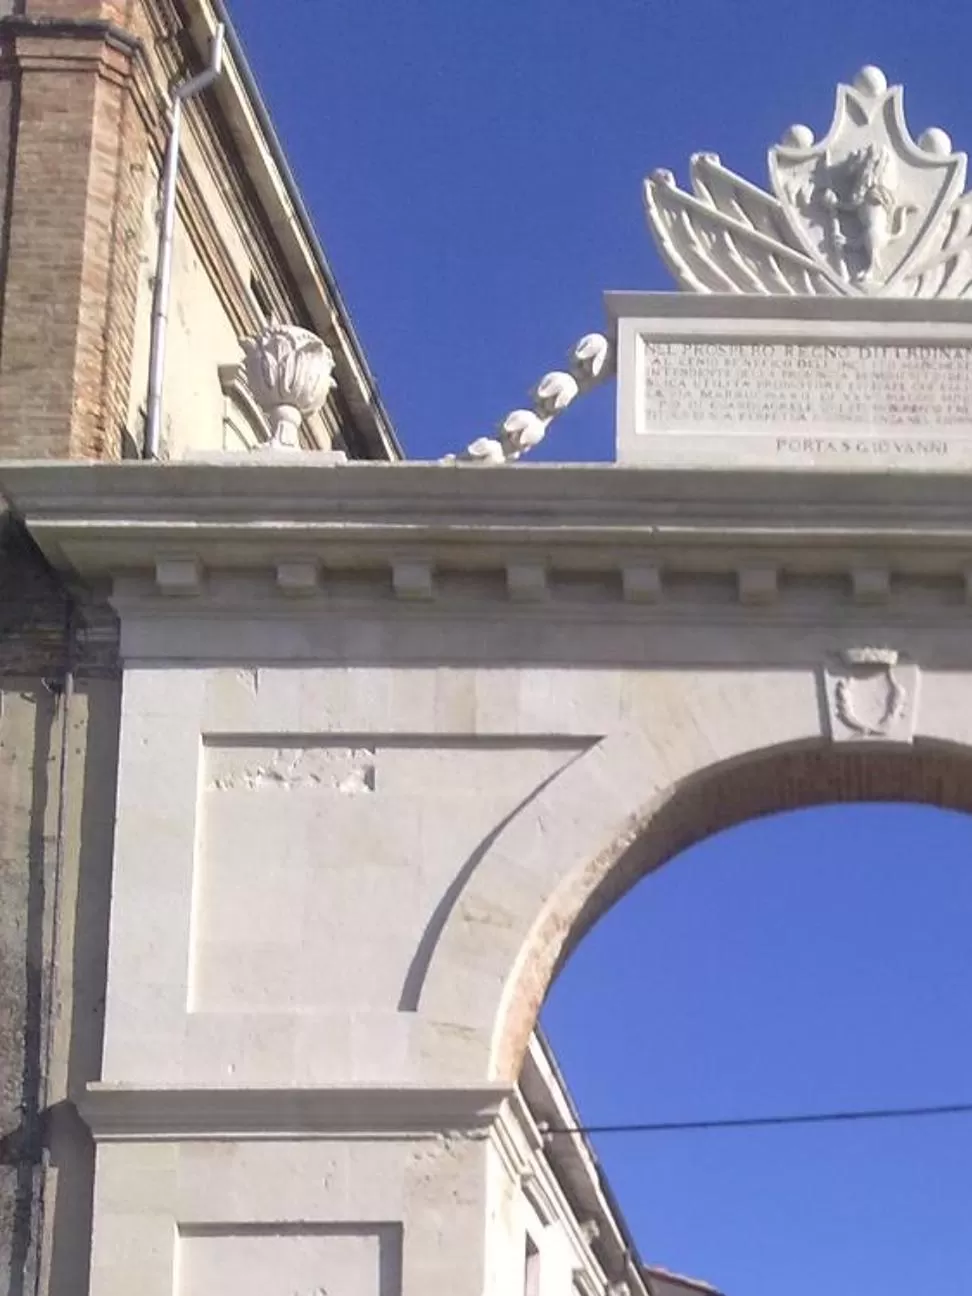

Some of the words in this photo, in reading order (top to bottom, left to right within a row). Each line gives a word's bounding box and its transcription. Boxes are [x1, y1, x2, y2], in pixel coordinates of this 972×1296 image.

[776, 438, 837, 453] PORTA
[841, 440, 852, 453] S
[856, 439, 949, 455] GIOVANNI
